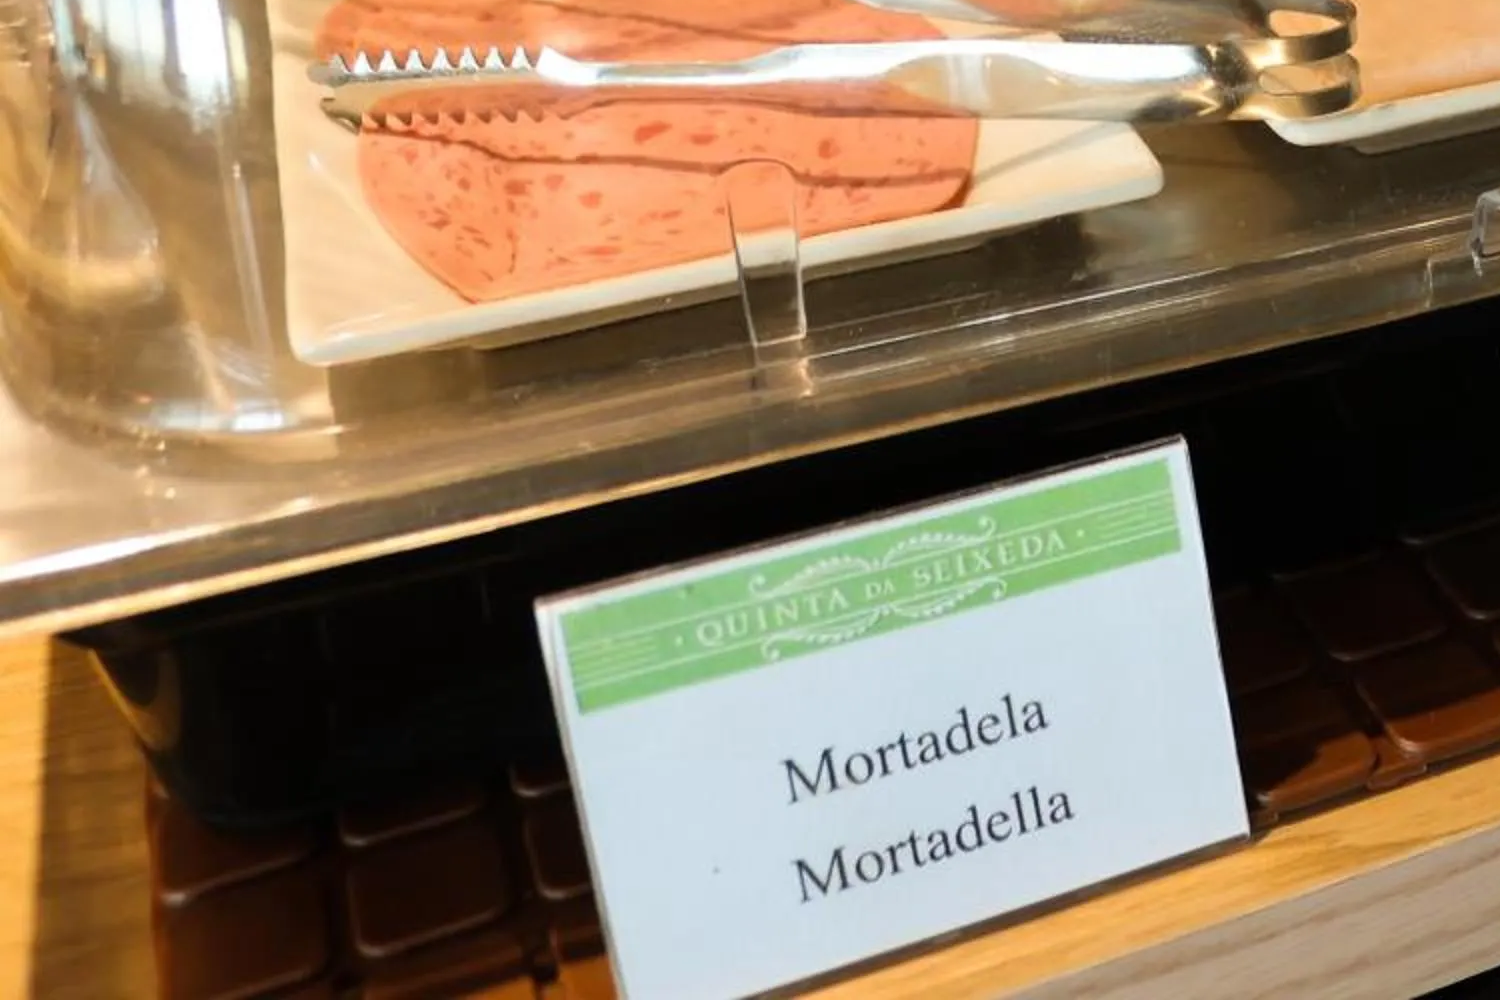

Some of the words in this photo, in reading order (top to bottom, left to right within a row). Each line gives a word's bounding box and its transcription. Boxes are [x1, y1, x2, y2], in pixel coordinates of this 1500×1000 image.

[695, 587, 850, 648] QUINTA
[912, 528, 1067, 588] SEIXEDA
[782, 693, 1050, 803] Mortadela
[791, 784, 1075, 903] Mortadella
